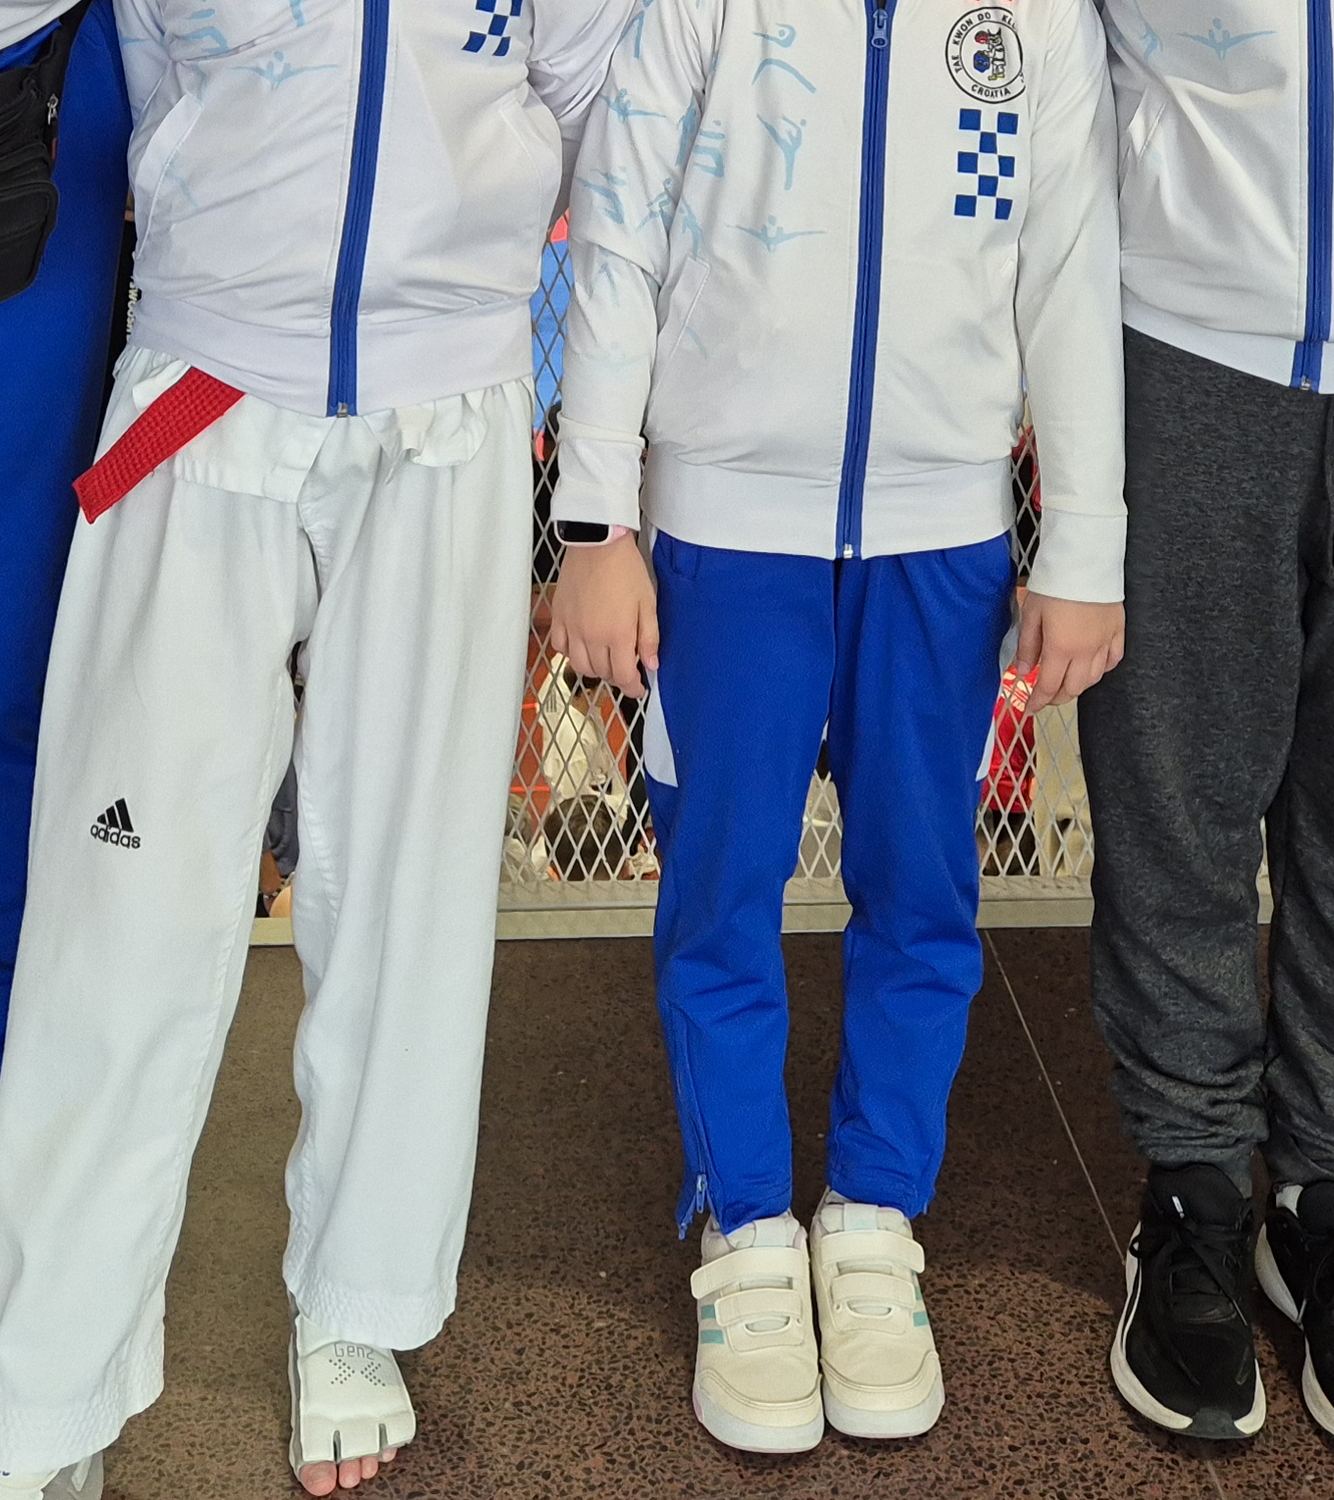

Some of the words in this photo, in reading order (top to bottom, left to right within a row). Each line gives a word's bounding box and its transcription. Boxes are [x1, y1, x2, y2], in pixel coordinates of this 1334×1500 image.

[977, 11, 992, 21] DO
[952, 18, 974, 46] KWON
[951, 54, 963, 74] TAE
[970, 84, 1012, 99] CROATIA
[90, 824, 142, 850] adidas
[334, 1342, 375, 1361] Gen2
